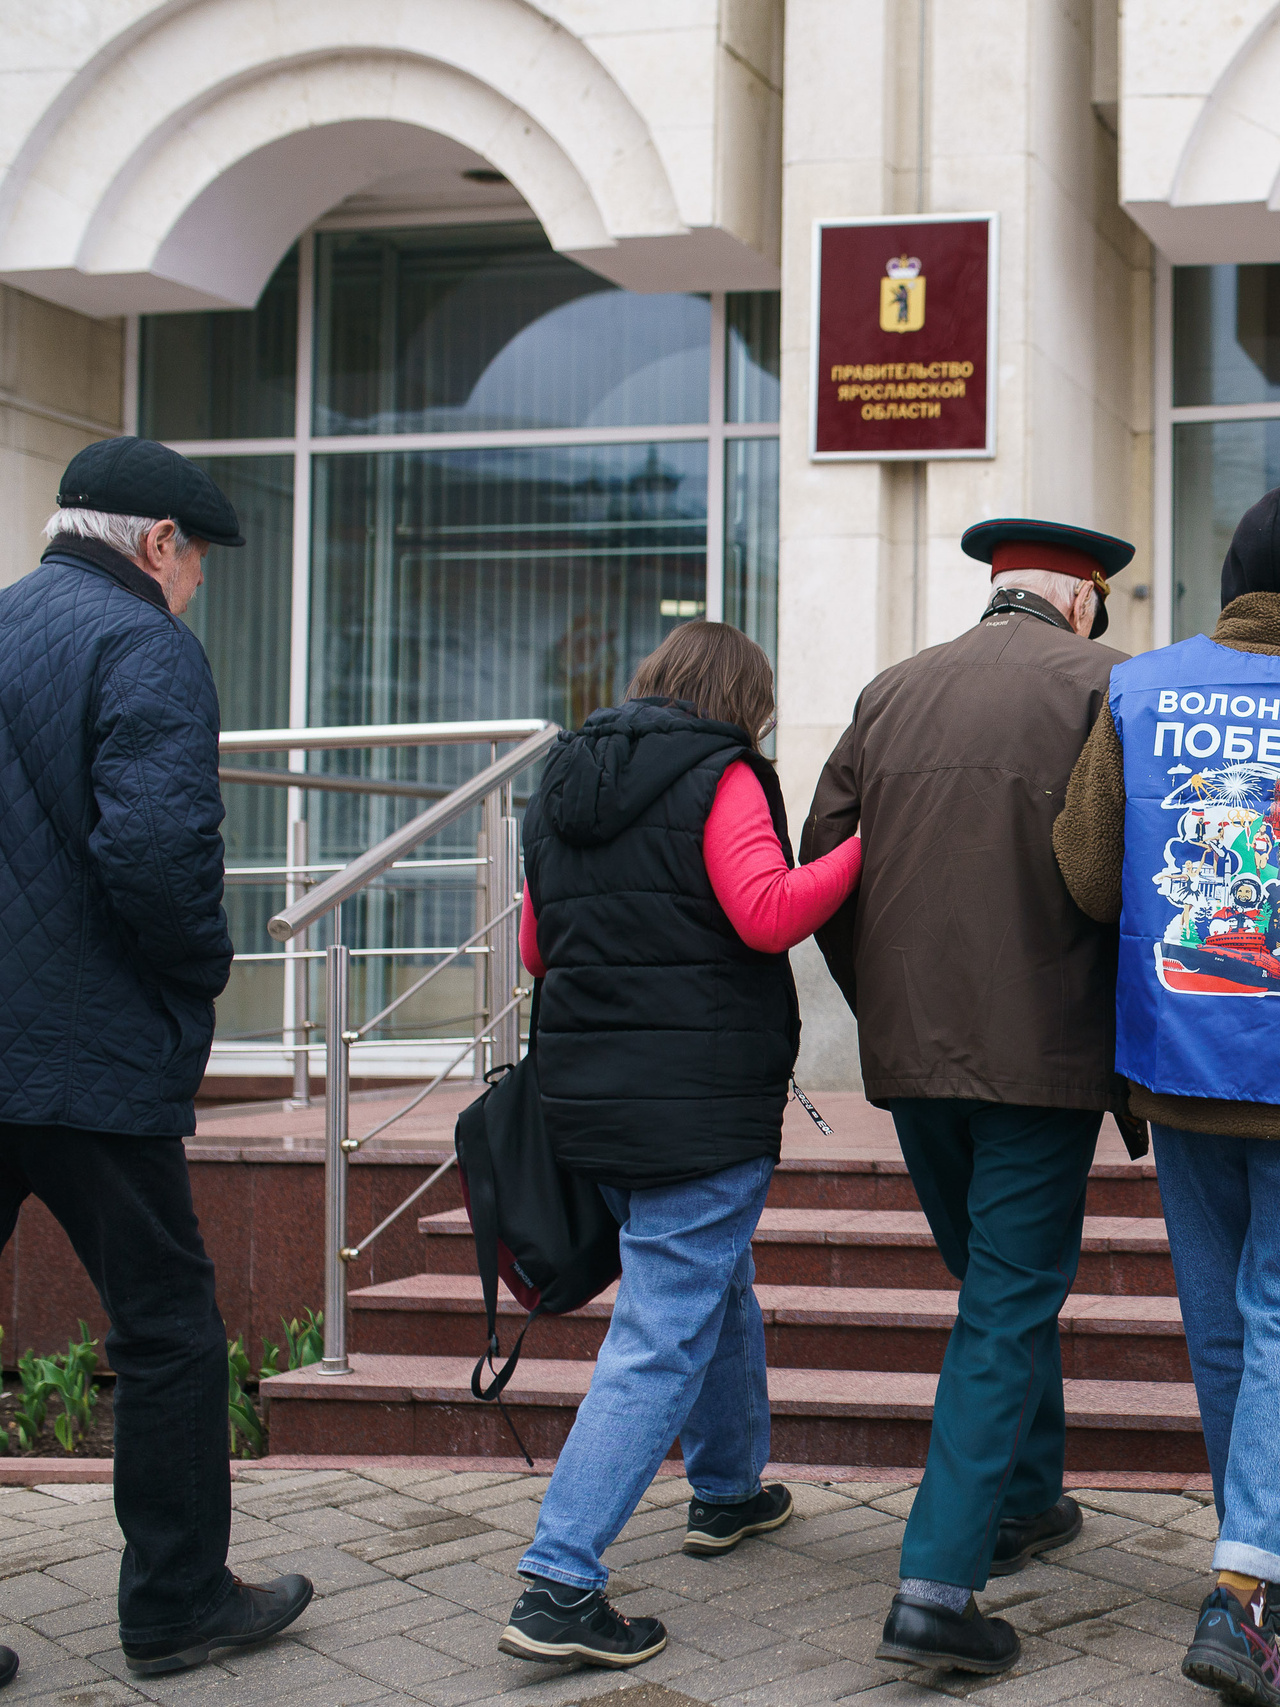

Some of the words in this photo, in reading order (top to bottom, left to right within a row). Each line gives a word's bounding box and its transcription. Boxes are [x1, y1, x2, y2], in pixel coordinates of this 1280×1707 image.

[831, 360, 974, 382] ПРАВИТЕЛЬСТВО
[837, 378, 966, 401] ЯРОСЛАВСКОЙ
[861, 401, 942, 420] ОБЛАСТИ
